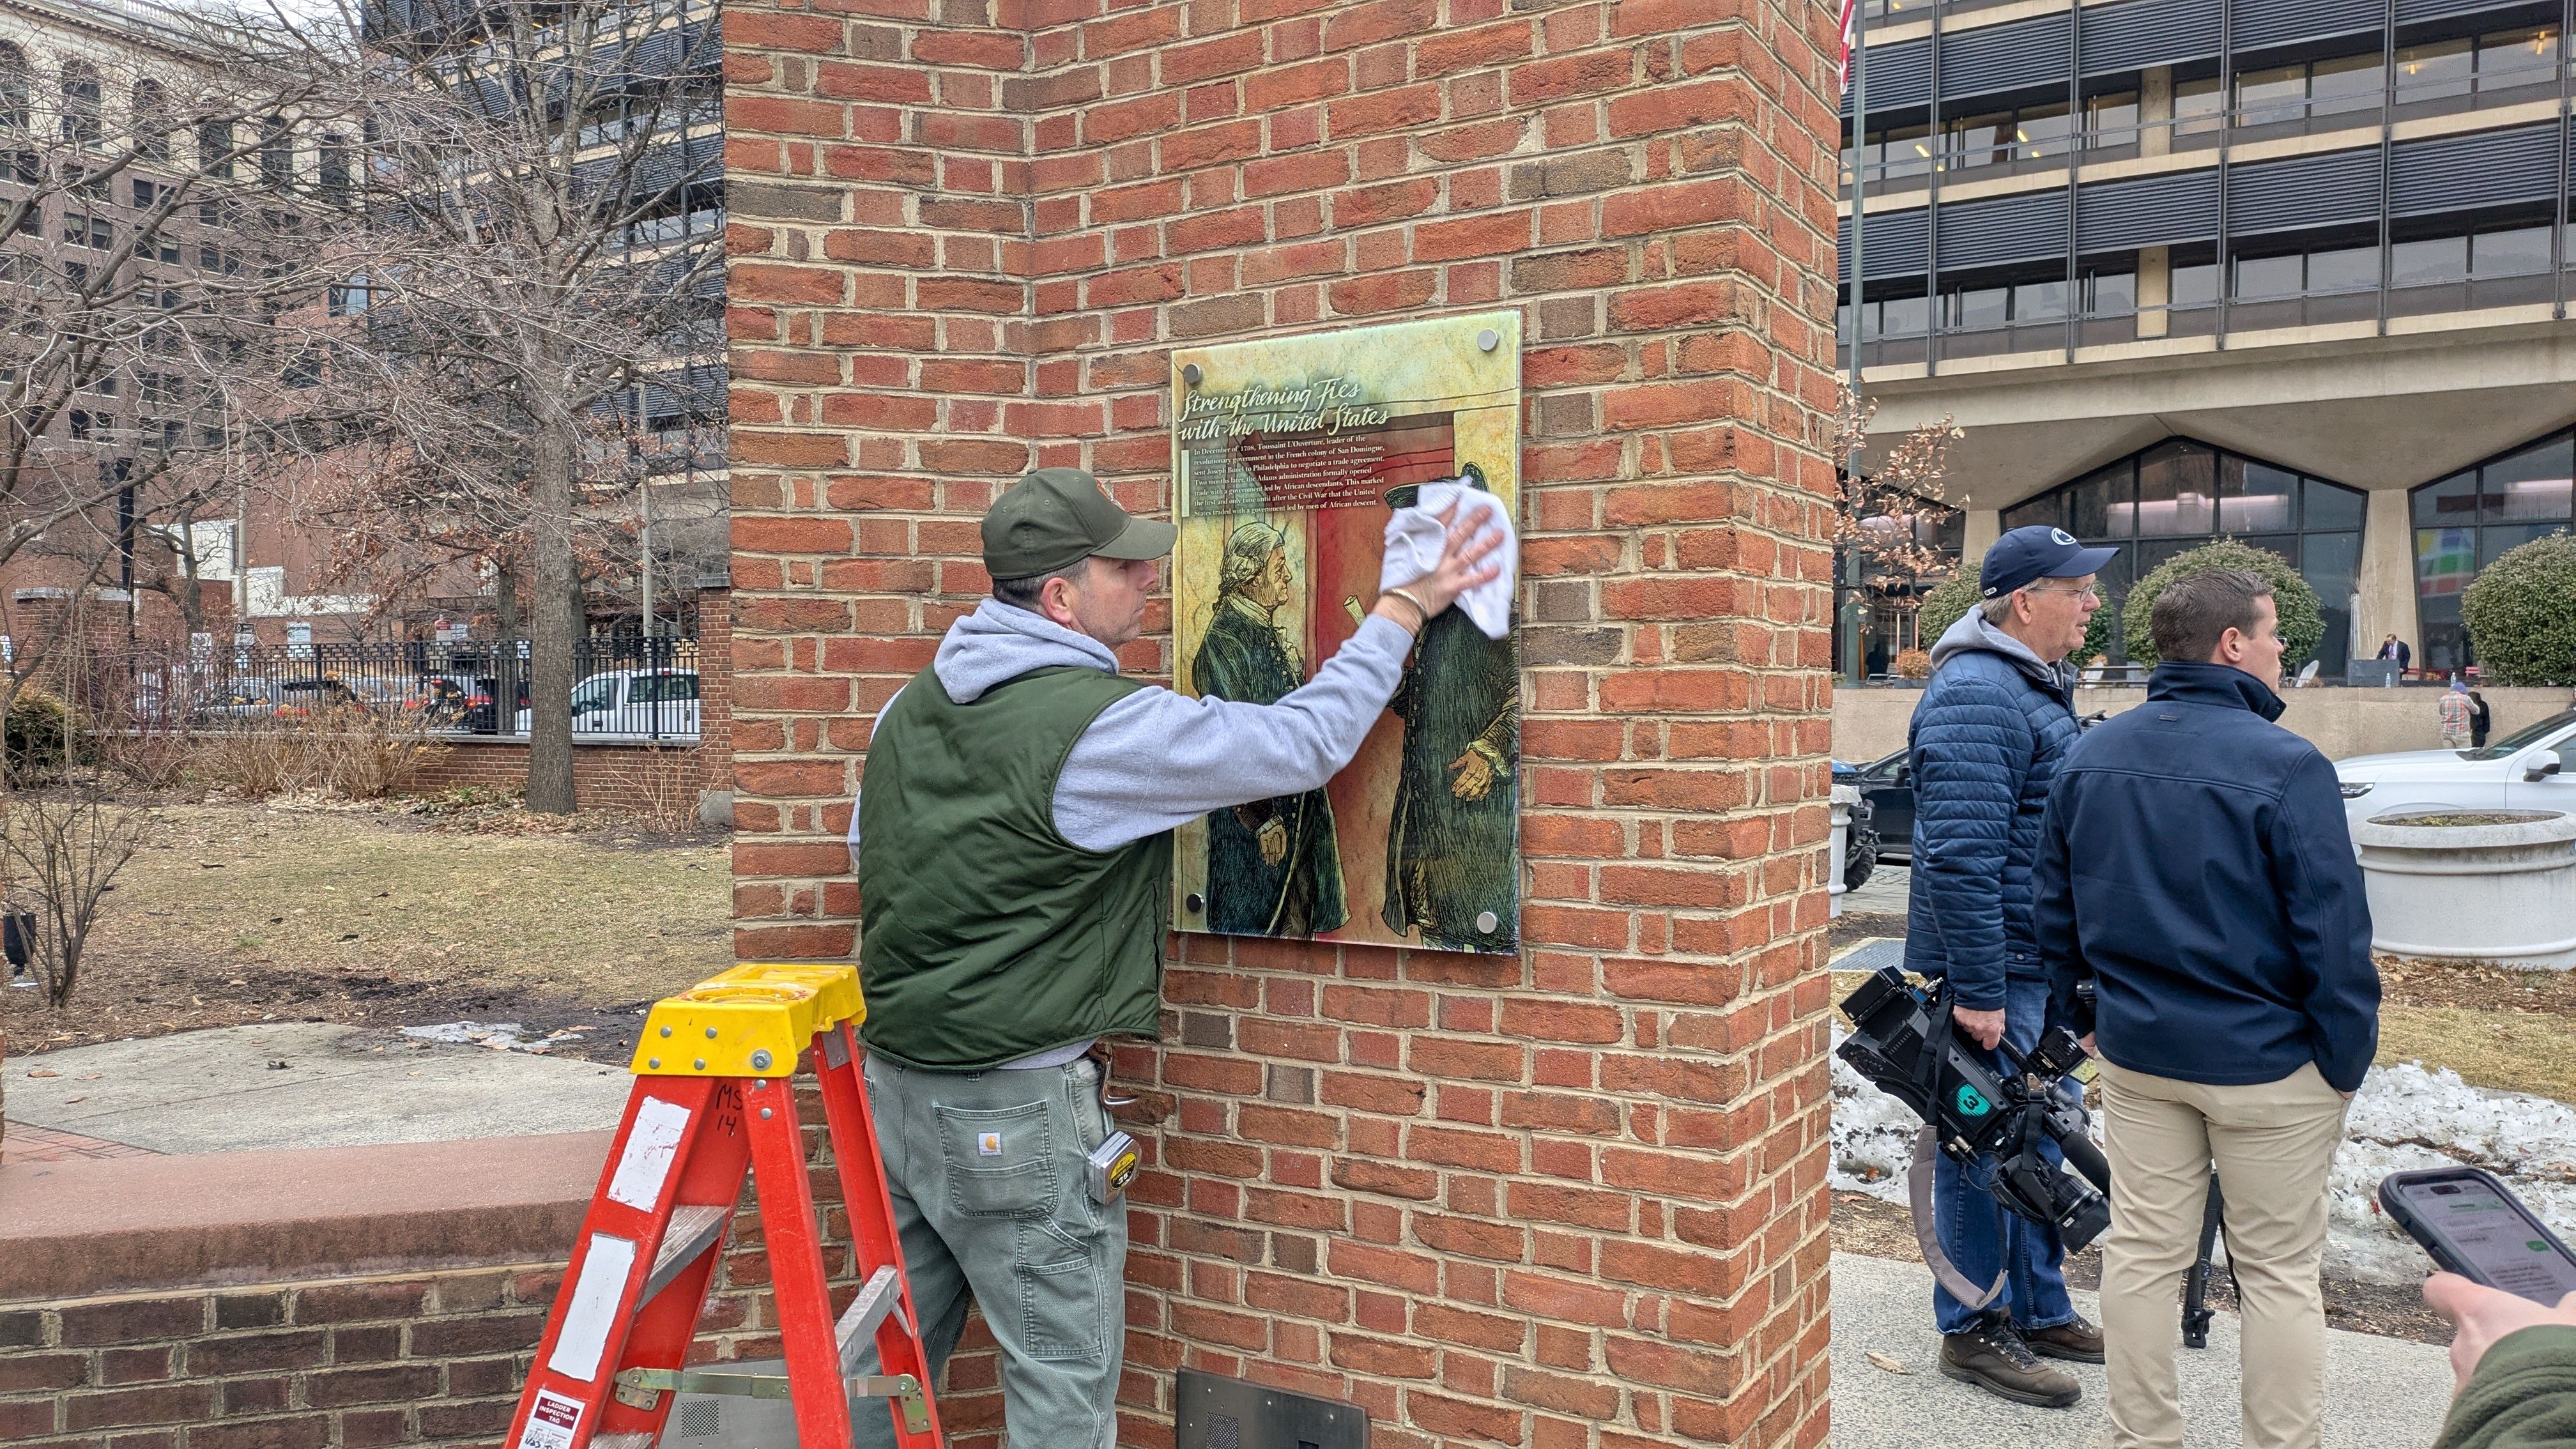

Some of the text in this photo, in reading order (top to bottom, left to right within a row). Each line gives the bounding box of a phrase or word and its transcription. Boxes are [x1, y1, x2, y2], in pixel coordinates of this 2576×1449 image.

[1177, 376, 1361, 422] Strengthening Ties
[1177, 402, 1390, 440] with the United States
[1201, 447, 1230, 455] December
[1232, 454, 1266, 464] government
[1286, 450, 1307, 459] French
[1308, 449, 1327, 457] colony
[1351, 445, 1385, 454] Domingue,
[1207, 468, 1226, 476] Joseph
[1253, 463, 1289, 471] Philadelphia
[1298, 460, 1327, 469] negotiate
[1350, 456, 1385, 466] agreement.
[1278, 470, 1322, 480] administration
[1349, 466, 1372, 477] opened
[1229, 486, 1263, 495] government
[1306, 480, 1344, 489] descendants.
[1361, 476, 1384, 484] marked
[1354, 487, 1376, 496] United
[1251, 505, 1285, 515] government
[716, 1084, 743, 1110] MS
[1963, 1095, 1979, 1110] 3
[717, 1114, 737, 1135] 14
[539, 1405, 574, 1422] INSPECTION
[547, 1400, 571, 1413] LADDER
[548, 1416, 560, 1424] TAG
